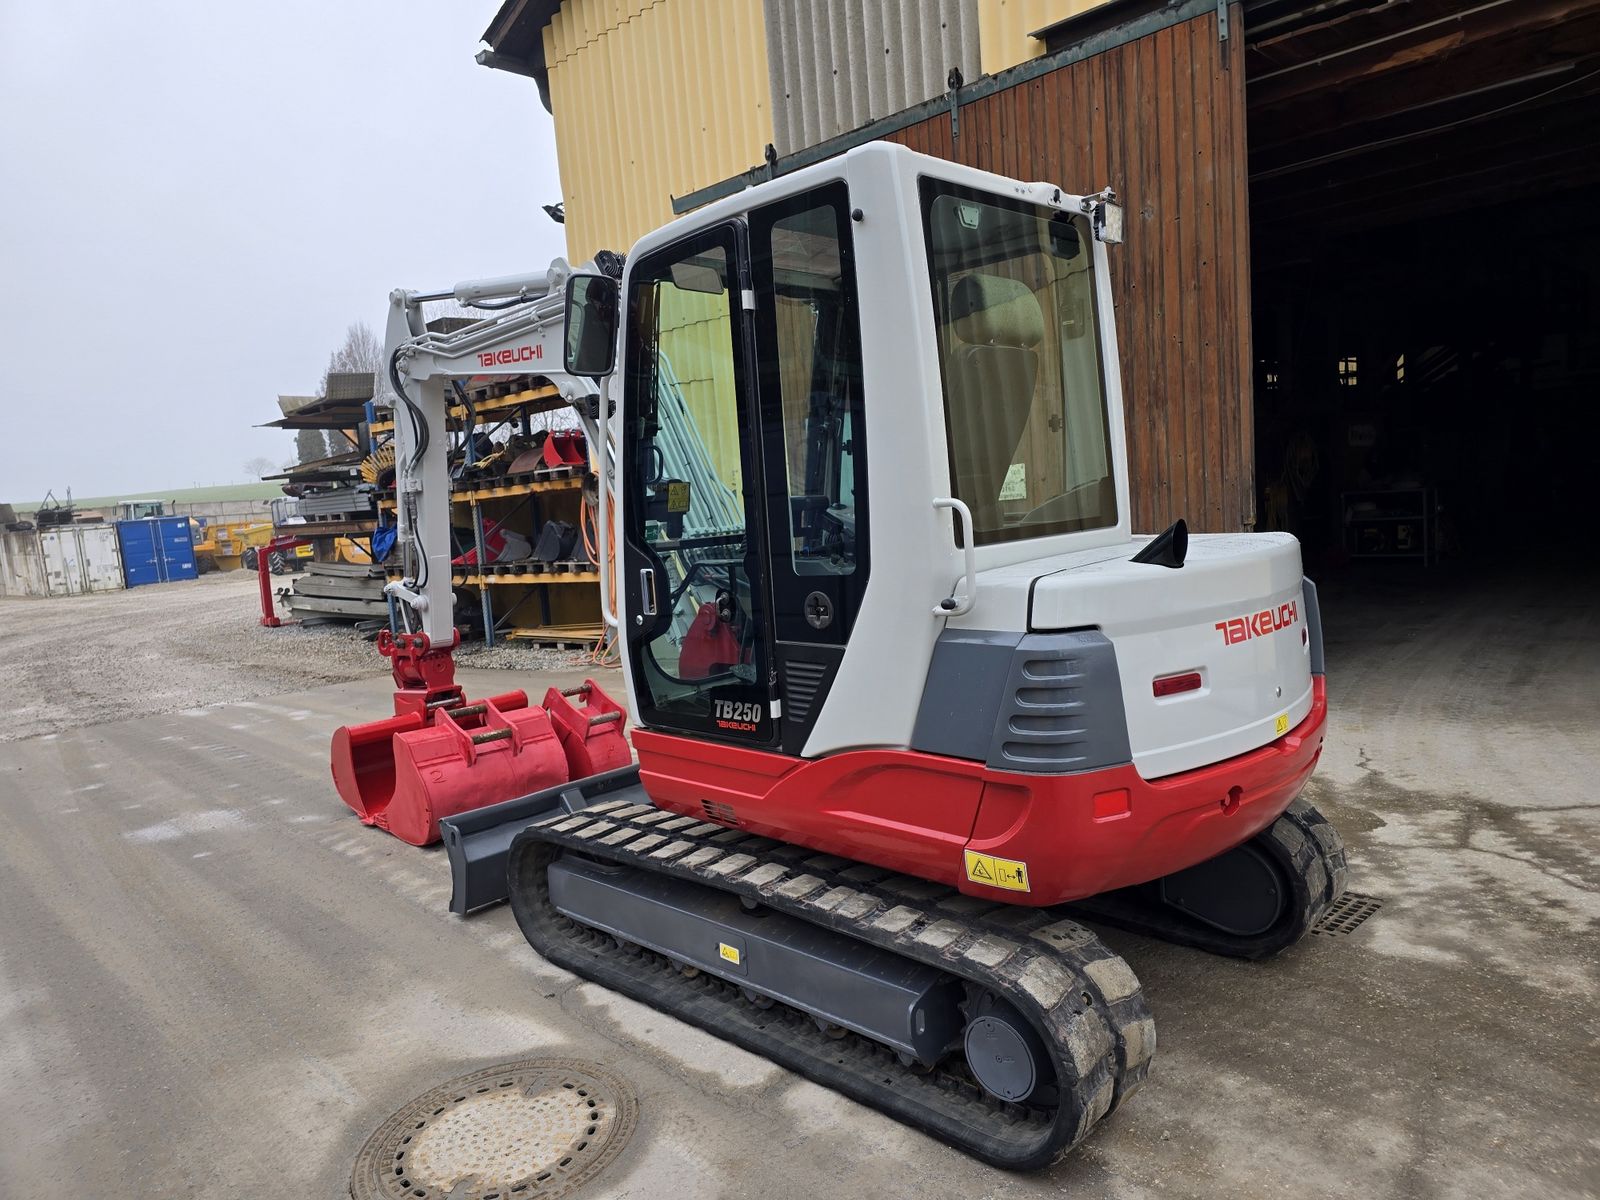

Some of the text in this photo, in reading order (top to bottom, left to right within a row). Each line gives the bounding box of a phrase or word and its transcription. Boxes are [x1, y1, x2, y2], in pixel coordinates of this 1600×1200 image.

[477, 344, 543, 367] TAKEUCHI
[1215, 600, 1298, 646] TAKEUCHI
[714, 699, 762, 723] TB250
